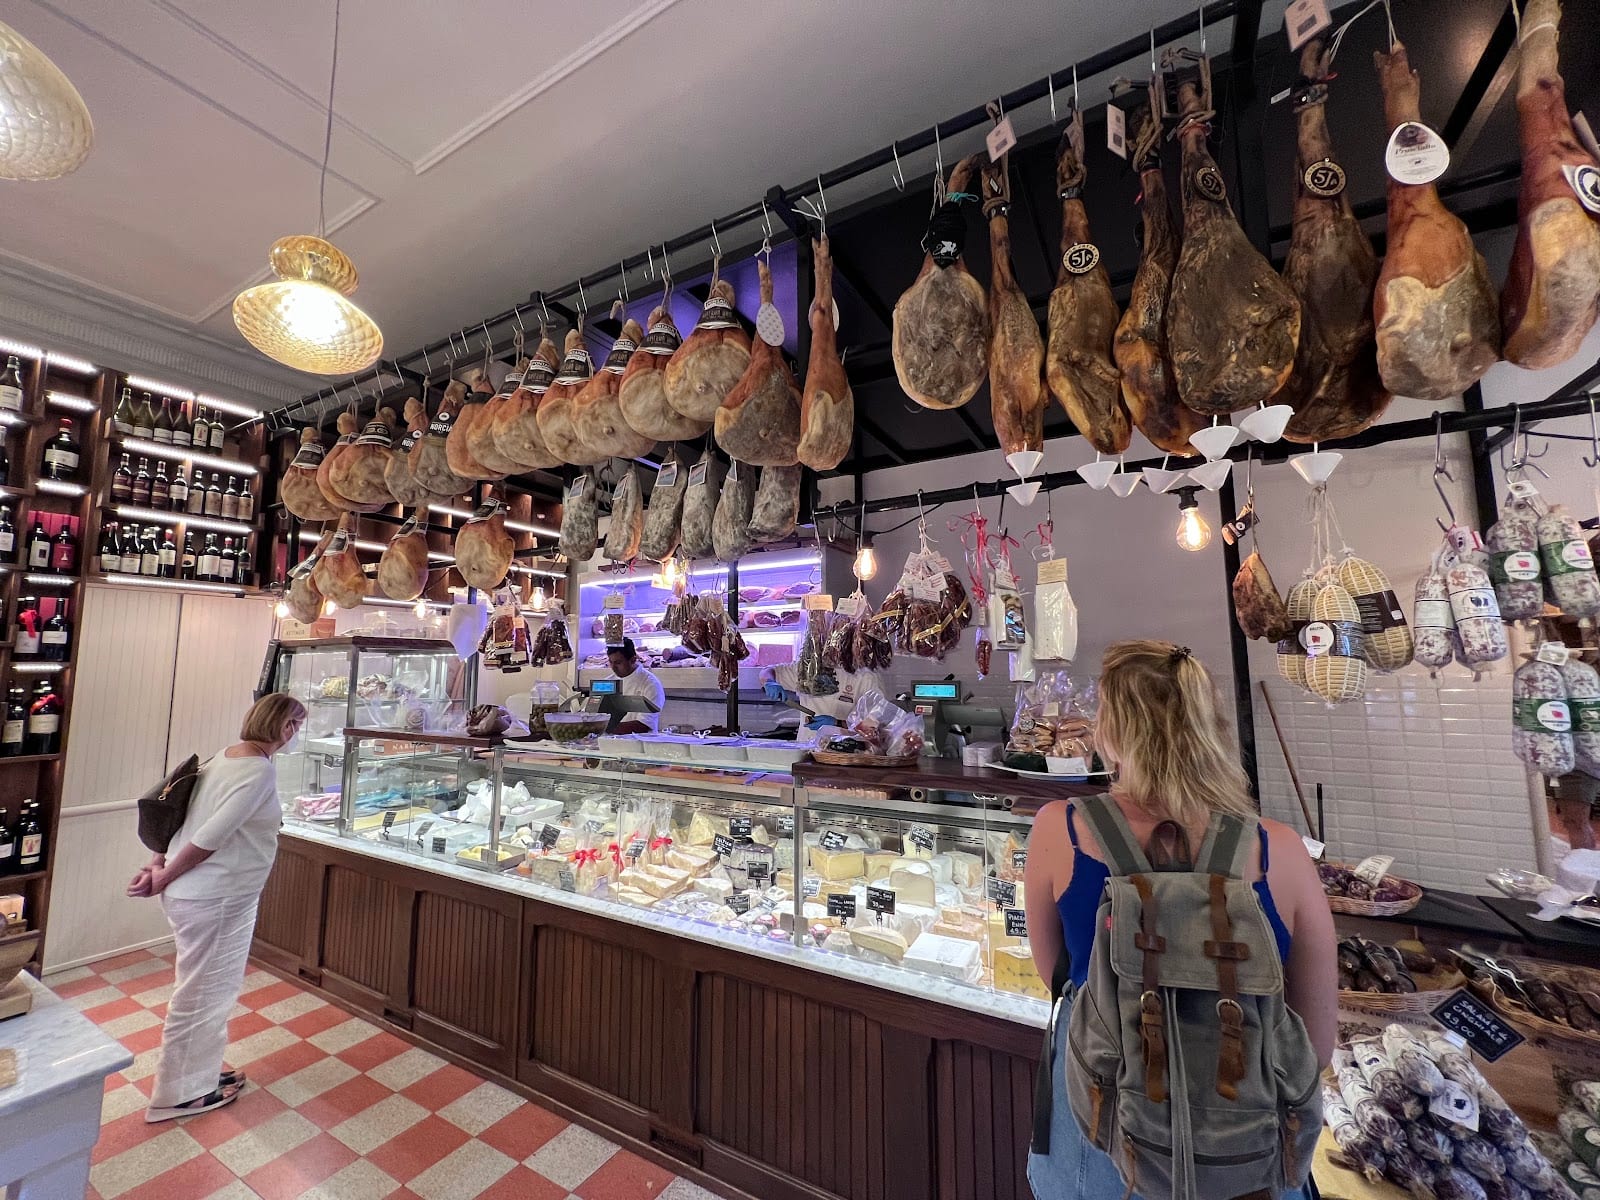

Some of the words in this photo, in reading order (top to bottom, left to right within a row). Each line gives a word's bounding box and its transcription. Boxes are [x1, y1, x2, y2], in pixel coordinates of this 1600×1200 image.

[1314, 169, 1334, 188] 5J
[401, 439, 415, 447] NOR
[1452, 1004, 1503, 1045] CINGHIALE
[1459, 1000, 1500, 1032] SALAME
